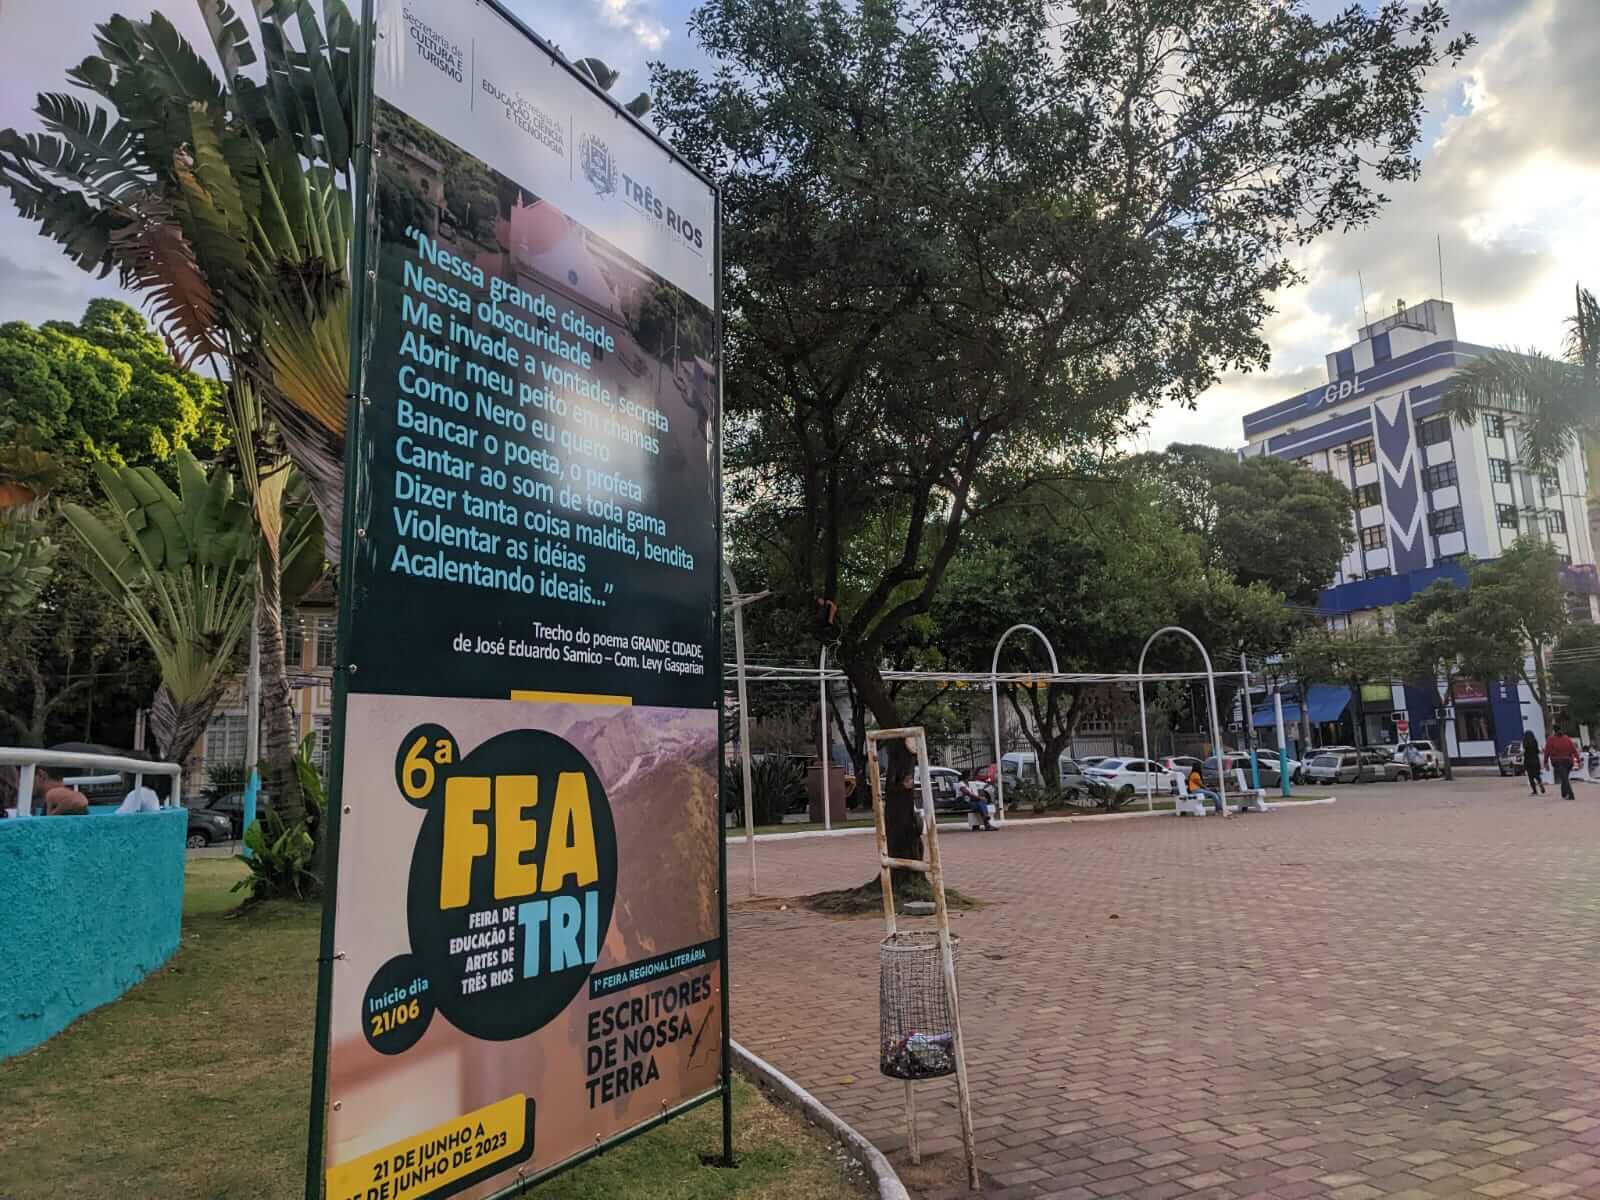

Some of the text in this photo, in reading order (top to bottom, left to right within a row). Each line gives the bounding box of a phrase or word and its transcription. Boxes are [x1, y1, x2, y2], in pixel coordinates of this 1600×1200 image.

[402, 8, 463, 57] Secretaria de
[410, 26, 463, 71] CULTURA E
[416, 42, 463, 83] TURISMO
[506, 108, 564, 157] E TECNOLOGIA
[622, 173, 663, 219] TRÊS
[667, 206, 703, 249] RIOS
[403, 261, 591, 370] Nessa obscuridade
[490, 275, 556, 322] grande
[561, 311, 615, 353] cidade
[400, 331, 660, 455] Abrir meu peito em chamas
[402, 295, 669, 432] Me invade a vontade, secreta
[398, 365, 609, 462] Como Nero eu quero
[397, 399, 642, 503] Bancar o poeta, o profeta
[395, 437, 666, 537] Cantar ao som de toda gama
[392, 506, 586, 573] Violentar as idéias
[395, 471, 694, 572] Dizer tanta coisa maldita, bendita
[390, 544, 534, 594] Acalentando
[453, 632, 472, 651] de
[474, 635, 505, 655] José
[508, 639, 560, 661] Eduardo
[563, 645, 603, 665] Samico
[614, 651, 640, 669] Com.
[642, 656, 662, 674] Levy
[664, 657, 704, 676] Gasparian
[533, 621, 704, 659] Trecho do poema GRANDE CIDADE,
[440, 771, 599, 911] FEA
[449, 925, 515, 955] EDUCAÇÃO E
[469, 905, 516, 929] FEIRA DE
[517, 890, 600, 980] TRI
[461, 967, 514, 996] TRÊS RIOS
[465, 947, 515, 973] ARTES DE
[603, 973, 628, 990] FEIRA
[629, 960, 669, 981] REGIONAL
[670, 949, 706, 969] LITERÁRIA
[369, 976, 429, 1014] Início dia
[371, 999, 420, 1038] 21/06
[587, 974, 711, 1042] ESCRITORES
[587, 1012, 692, 1076] DE NOSSA
[585, 1055, 660, 1109] TERRA
[367, 1131, 507, 1200] DE JUNHO DE 2023
[373, 1121, 485, 1182] 21 DE JUNHO A
